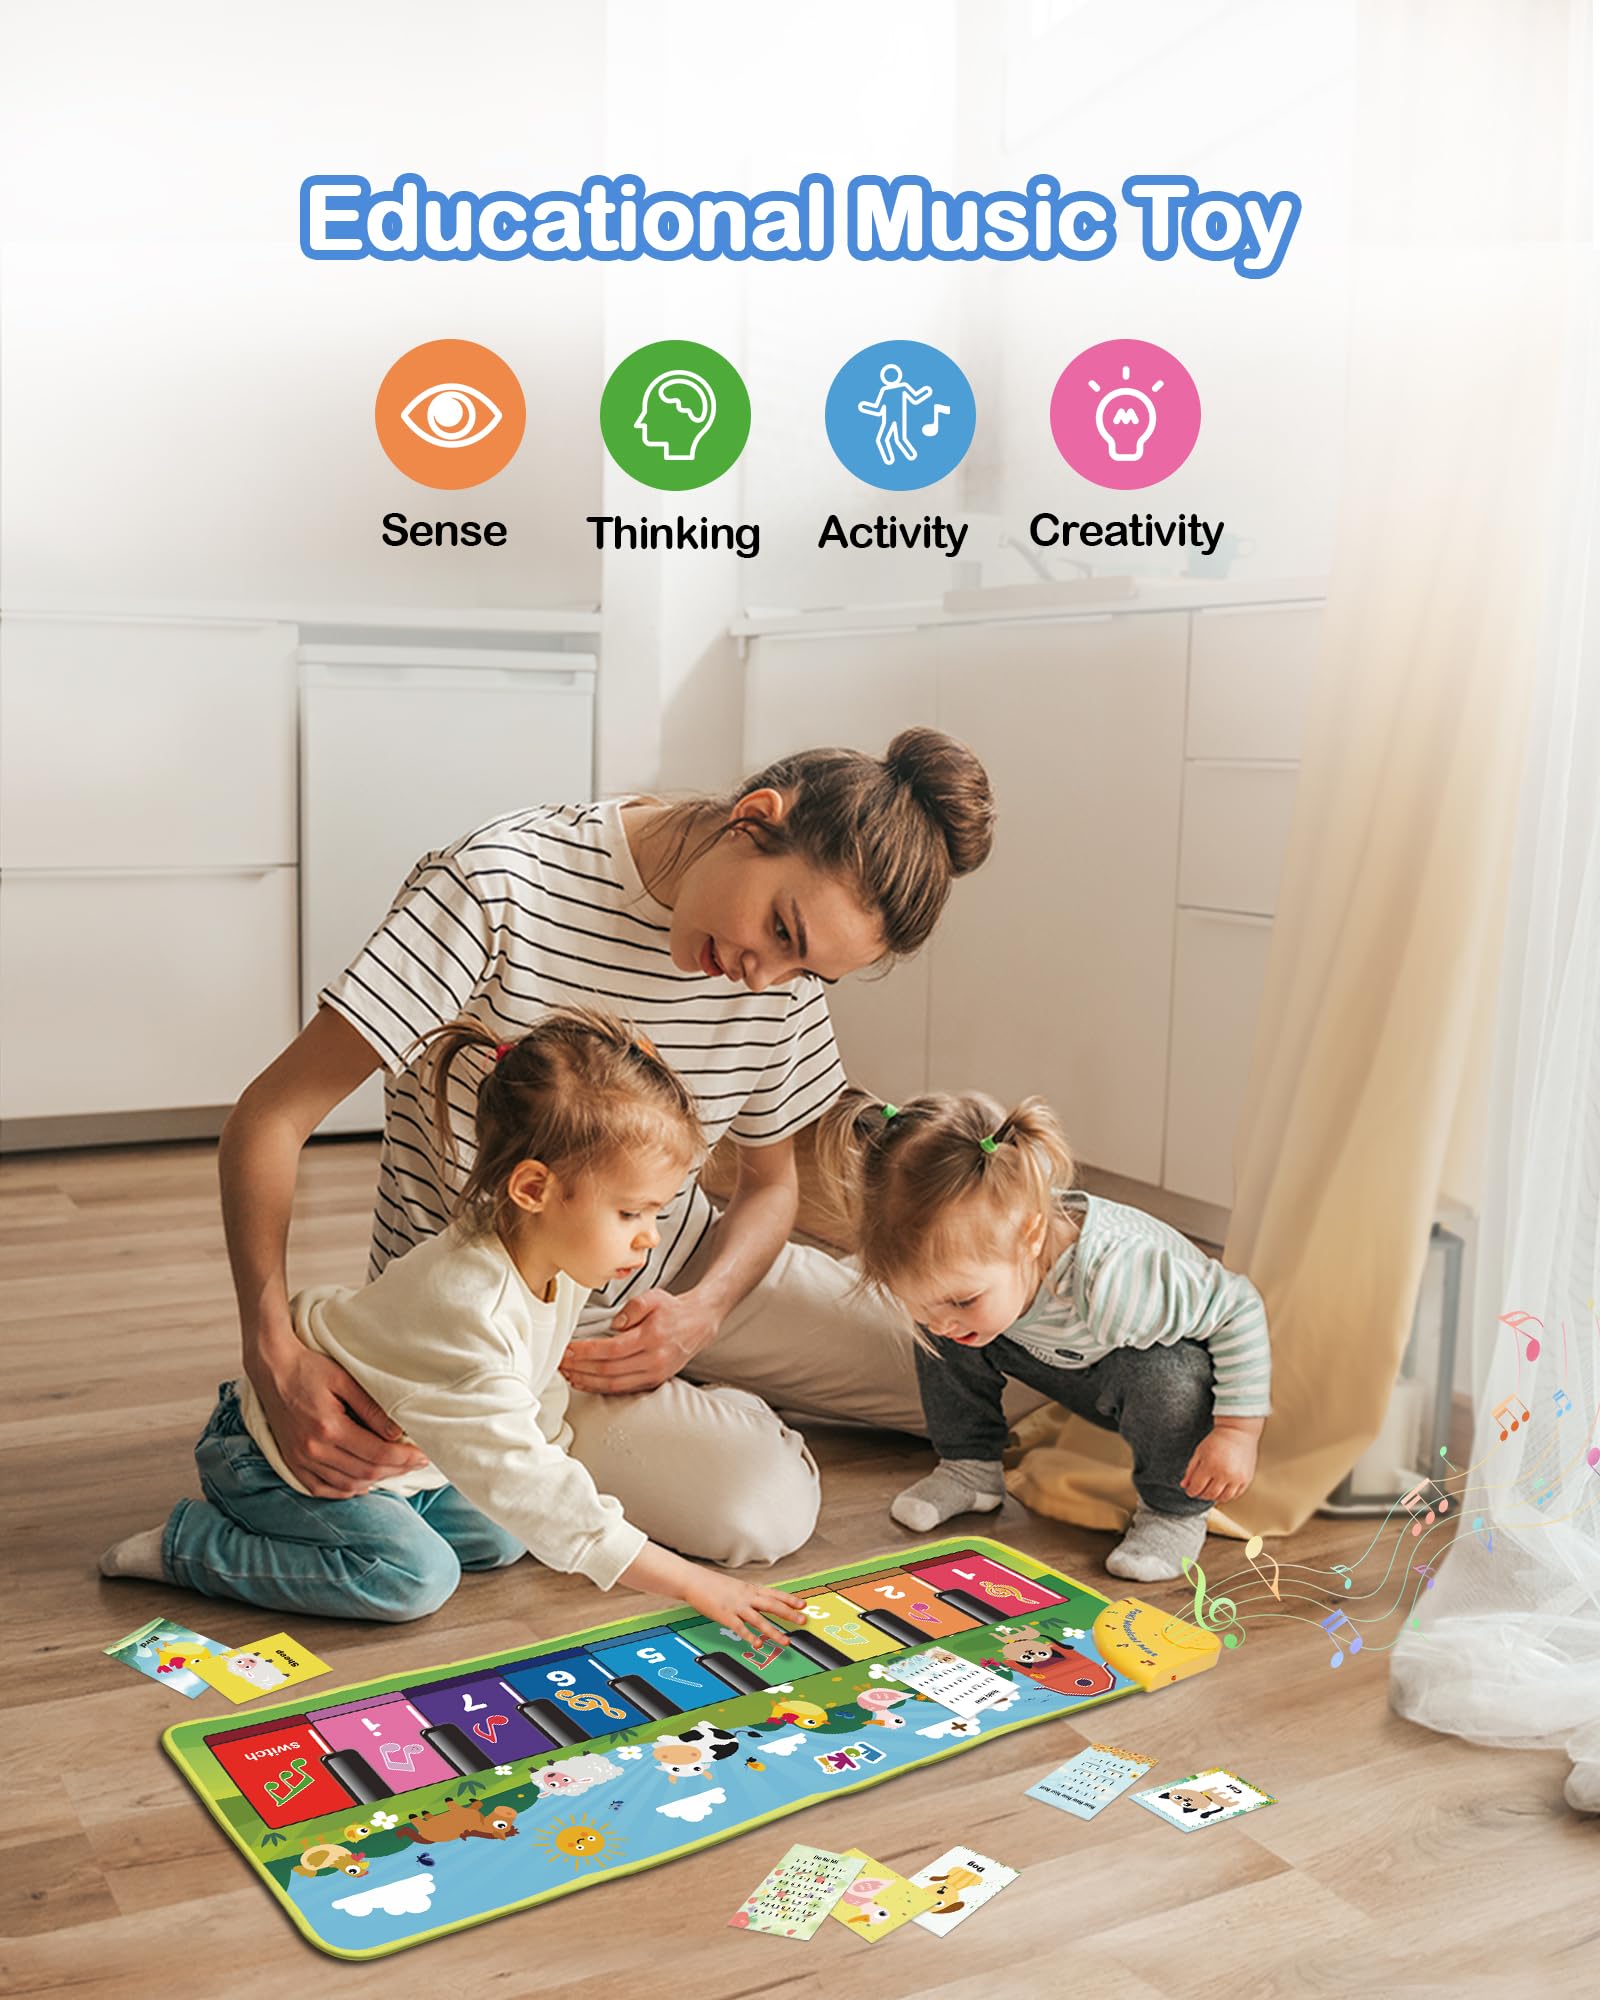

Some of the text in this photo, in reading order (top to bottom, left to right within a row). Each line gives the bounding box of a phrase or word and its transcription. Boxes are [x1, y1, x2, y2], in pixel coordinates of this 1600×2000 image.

[951, 1568, 977, 1581] 1
[874, 1585, 907, 1600] 2
[801, 1605, 831, 1620] 3
[140, 1635, 160, 1649] Bird
[275, 1649, 300, 1668] Sheep
[636, 1647, 667, 1664] 5
[546, 1670, 577, 1687] 6
[462, 1693, 488, 1712] 7
[244, 1741, 301, 1761] switch
[1226, 1784, 1242, 1794] Cat
[966, 1860, 986, 1873] Dog
